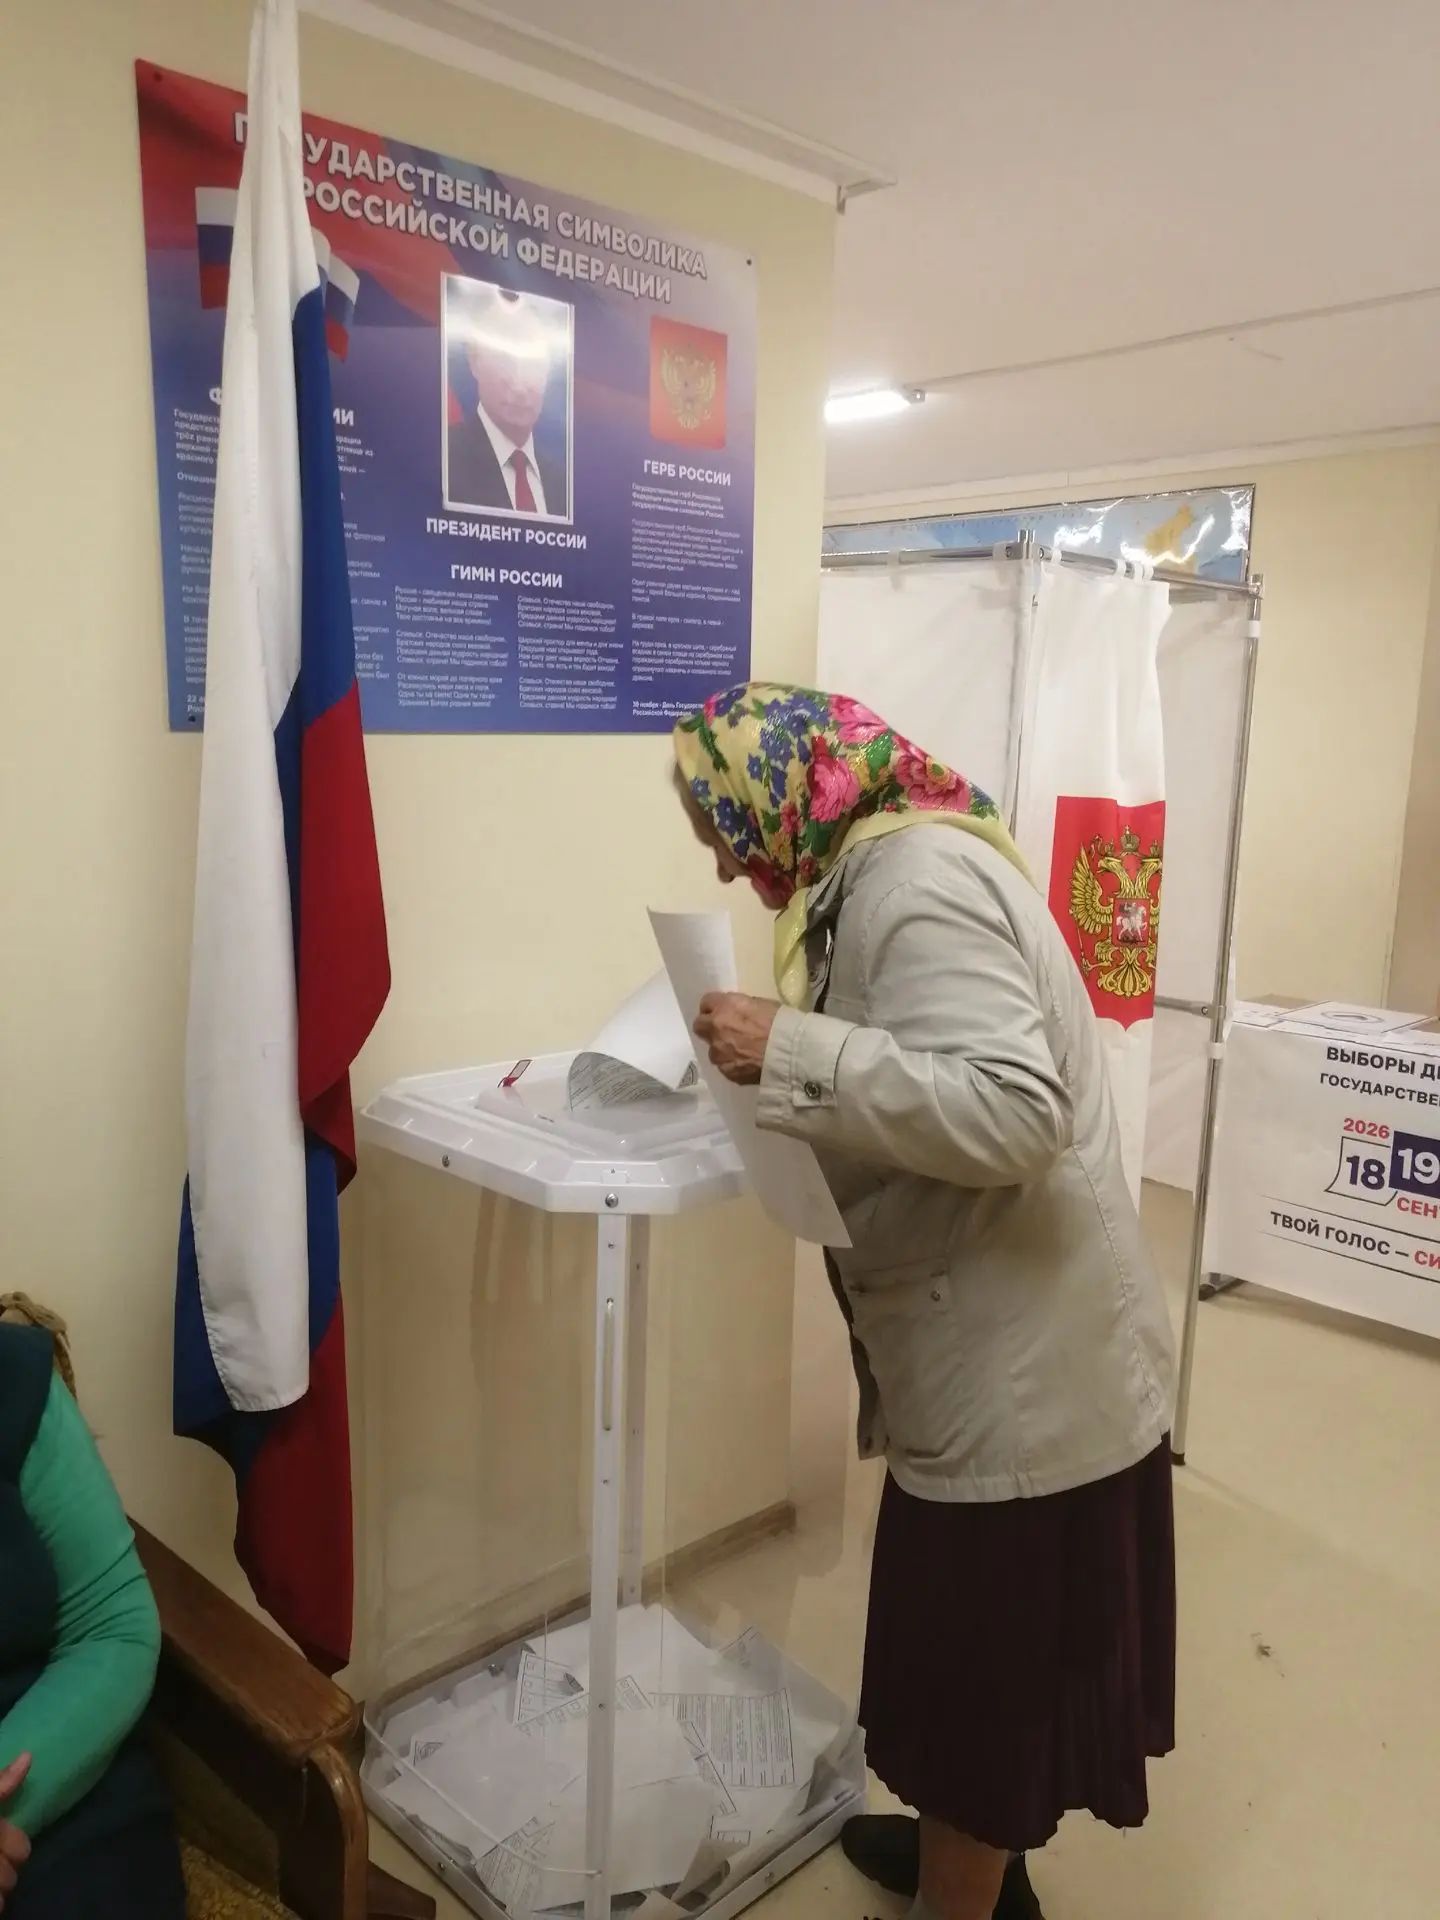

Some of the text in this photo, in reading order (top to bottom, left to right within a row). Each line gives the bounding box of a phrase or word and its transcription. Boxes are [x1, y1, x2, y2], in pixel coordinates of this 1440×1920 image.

[234, 111, 707, 279] ГУДАРСТВЕННАЯ СИМВОЛИКА
[516, 237, 671, 303] ФЕДЕРАЦИИ
[643, 459, 731, 486] ГЕРБ РОССИИ
[426, 517, 587, 550] ПРЕЗИДЕНТ РОССИИ
[451, 564, 563, 588] ГИМН РОССИИ
[1326, 1046, 1415, 1075] ВЫБОРЫ
[1320, 1072, 1440, 1107] ГОСУДАРСТВЕ
[1343, 1117, 1390, 1139] 2026
[1346, 1148, 1440, 1190] 18 19
[1396, 1197, 1440, 1219] СЕН
[1271, 1211, 1320, 1237] ТВОЙ
[1325, 1226, 1390, 1256] ГОЛОС
